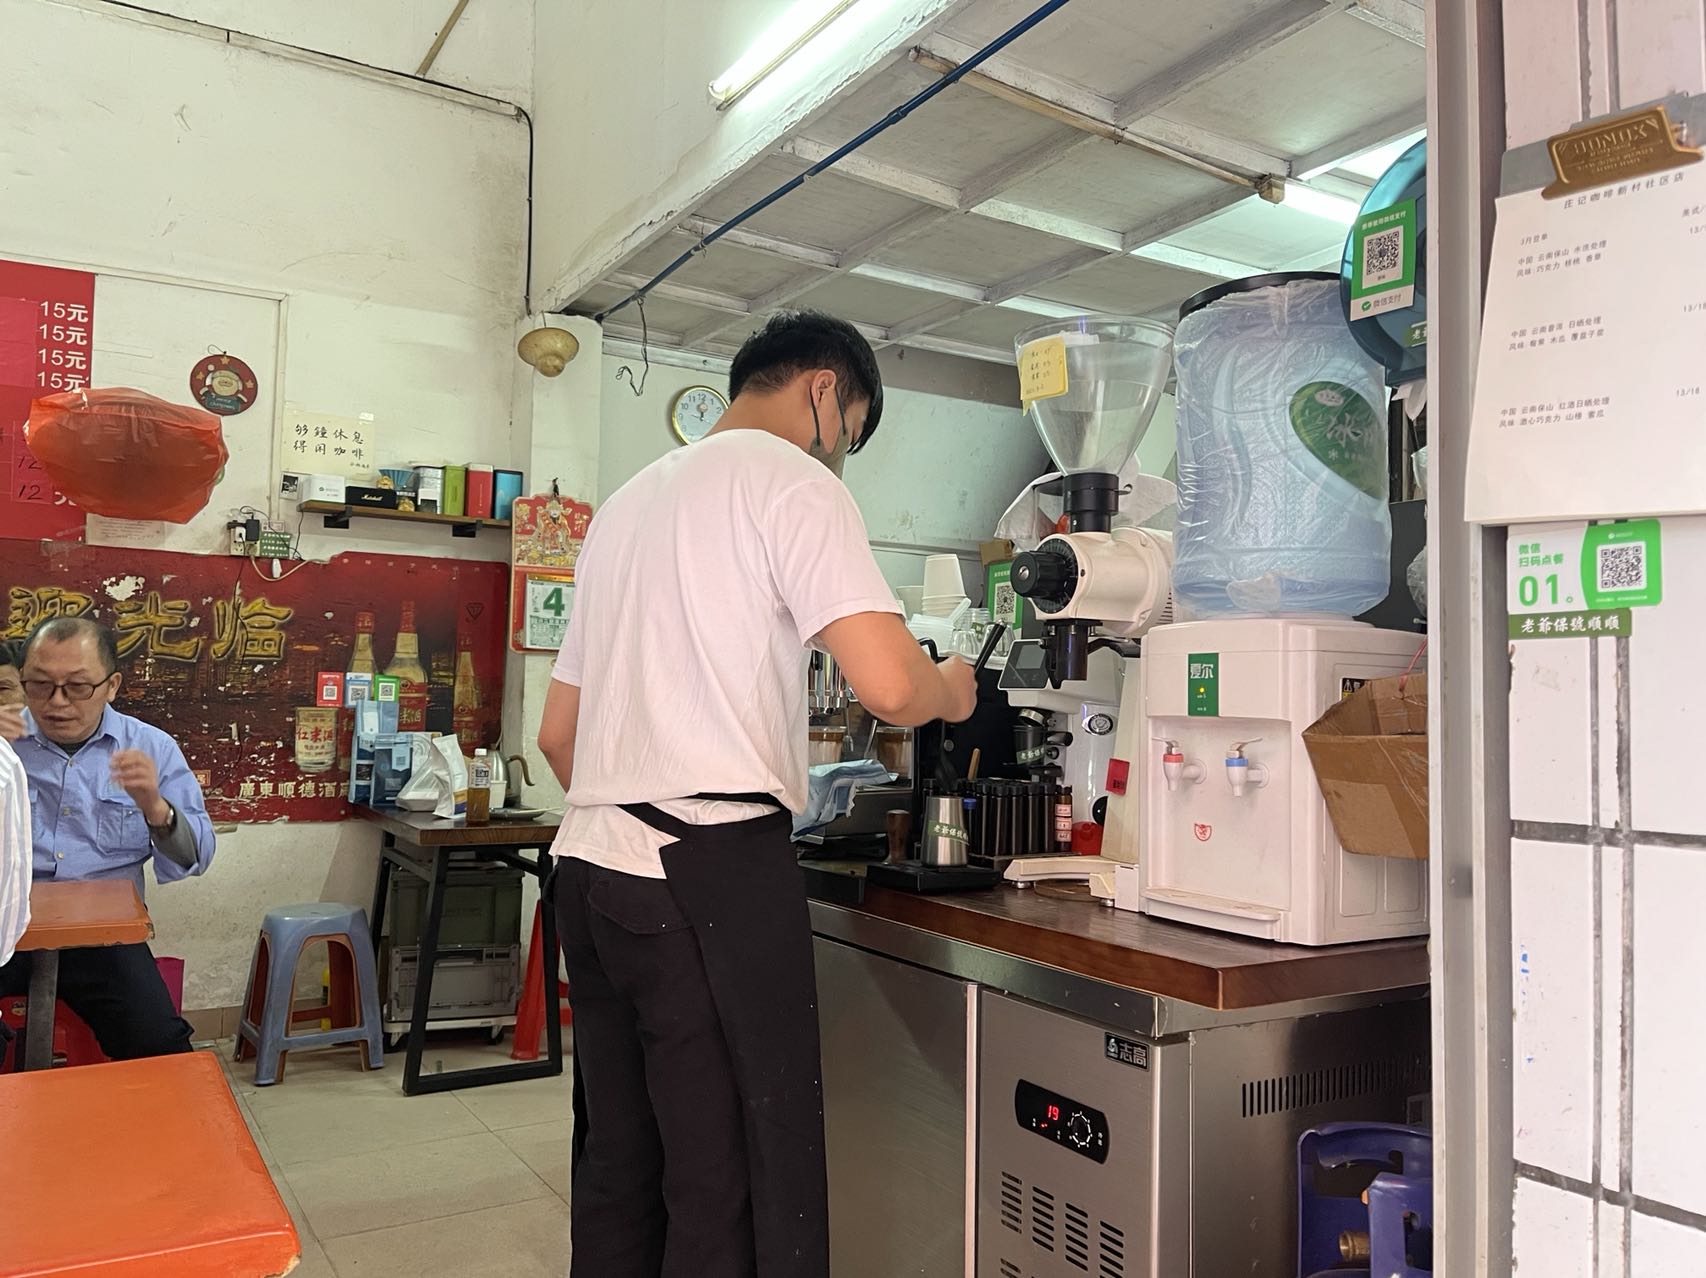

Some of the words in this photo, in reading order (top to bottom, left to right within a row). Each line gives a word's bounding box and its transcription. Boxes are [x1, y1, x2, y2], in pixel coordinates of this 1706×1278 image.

[40, 301, 89, 323] 15元
[39, 324, 88, 346] 15元
[38, 348, 87, 370] 15元
[37, 372, 86, 394] 15元
[18, 484, 43, 500] 12
[1519, 543, 1541, 555] 微信
[1519, 553, 1564, 567] 扫码点餐
[543, 587, 565, 617] 4
[1190, 663, 1214, 679] 夏尔
[1119, 1042, 1147, 1067] 志高
[1048, 1105, 1060, 1121] 19
